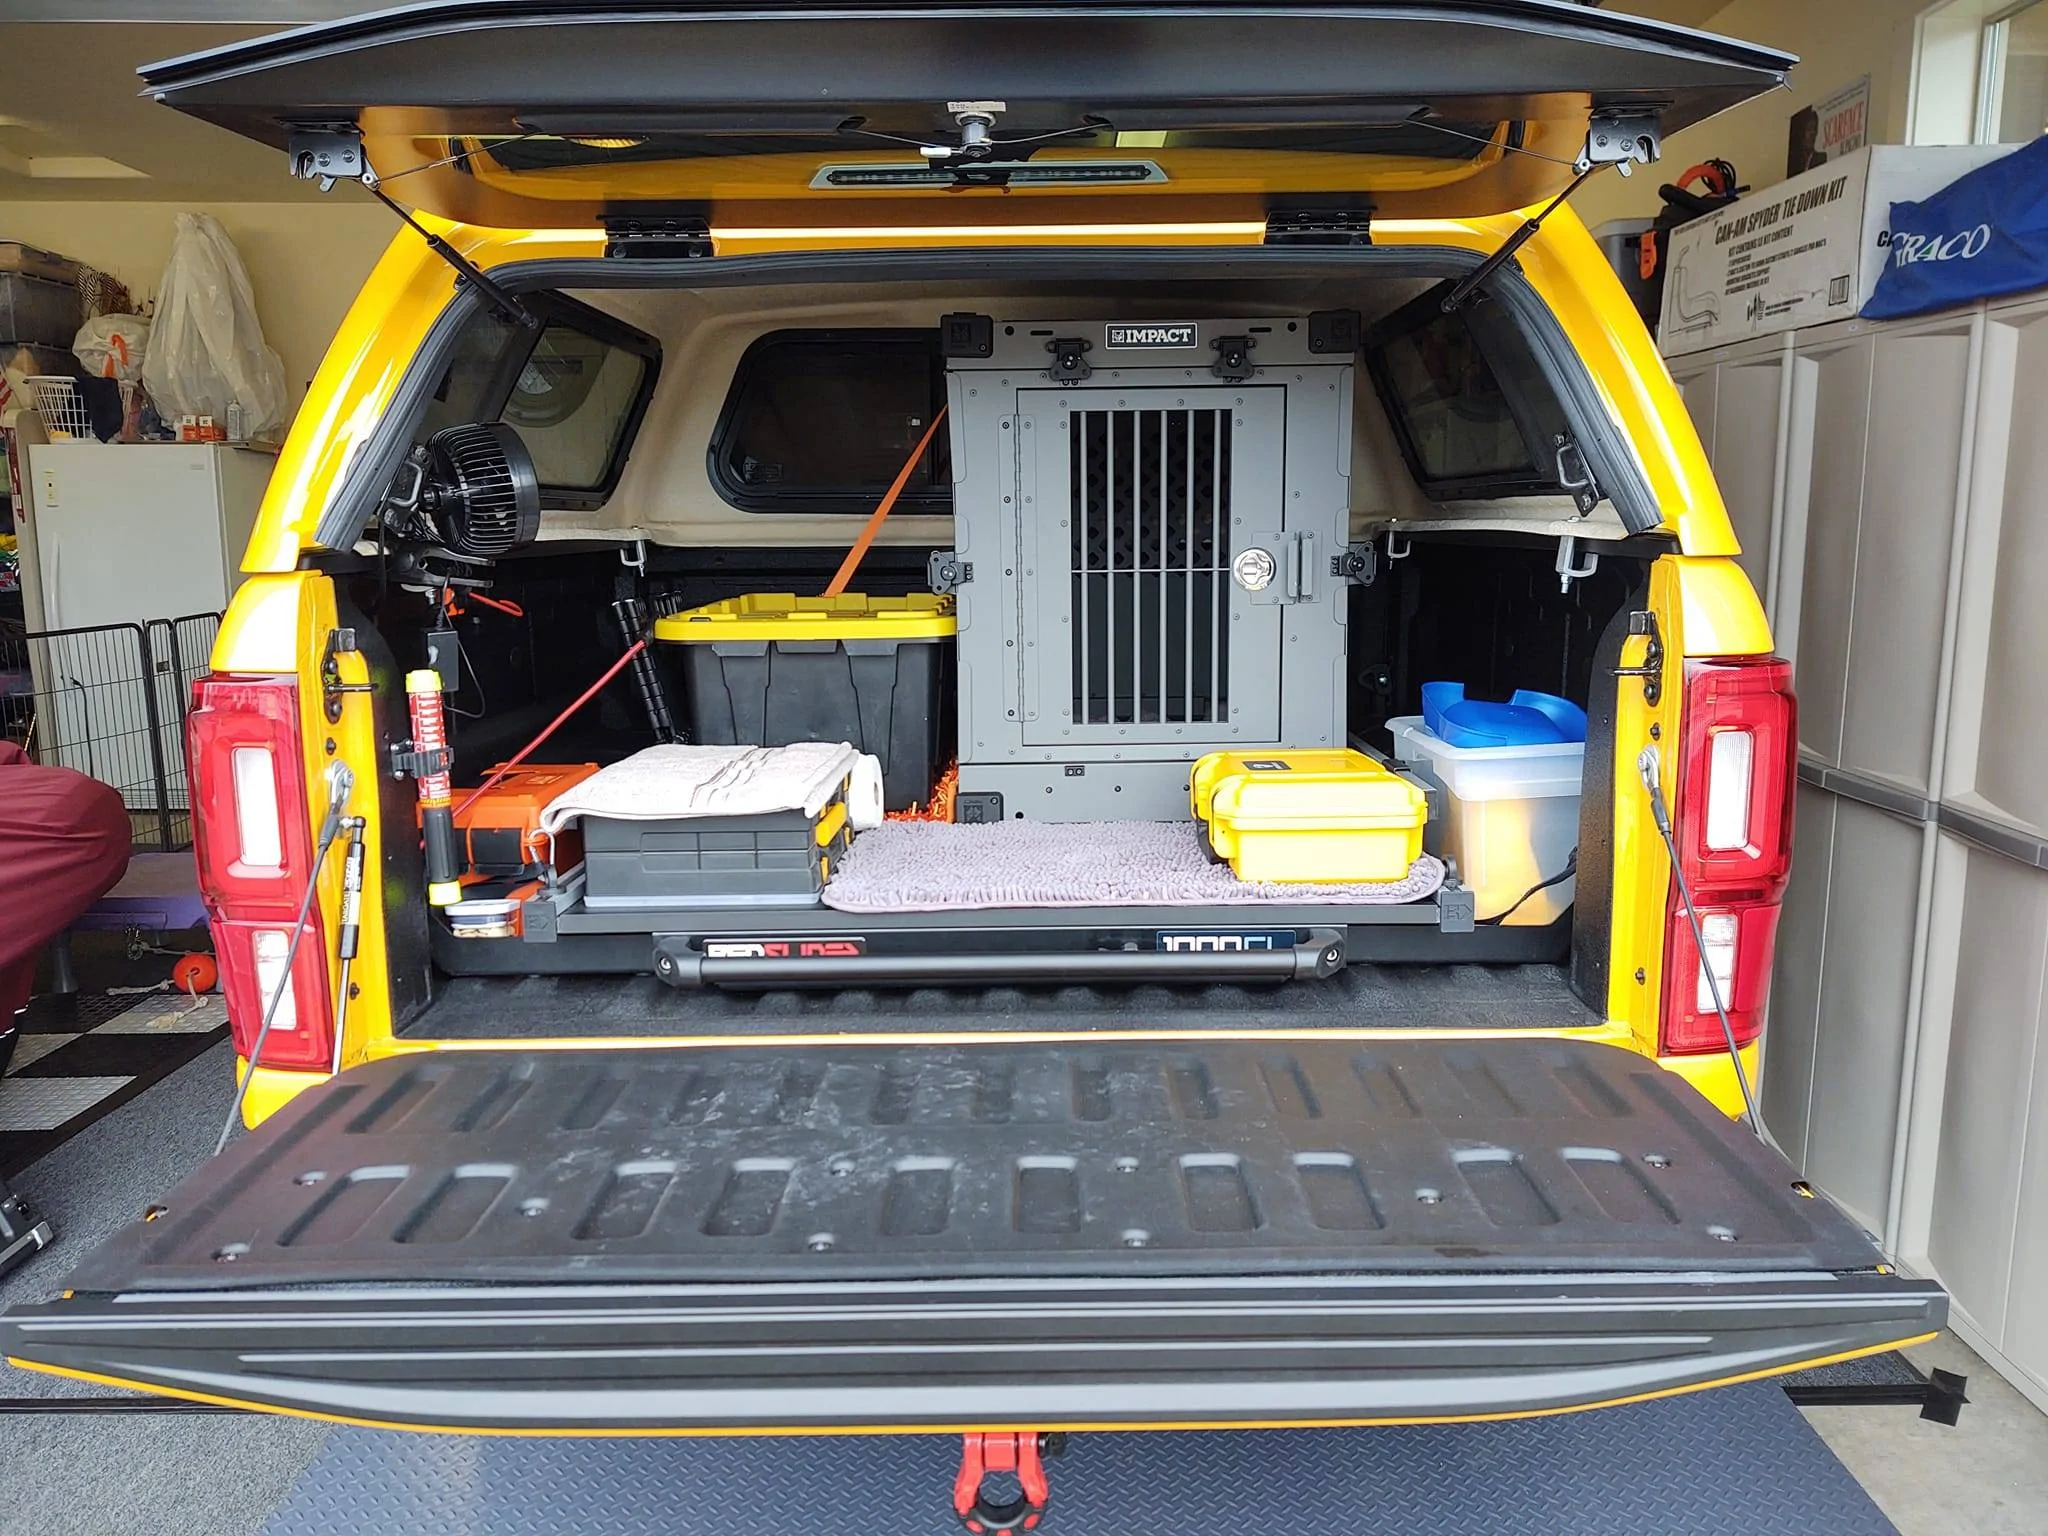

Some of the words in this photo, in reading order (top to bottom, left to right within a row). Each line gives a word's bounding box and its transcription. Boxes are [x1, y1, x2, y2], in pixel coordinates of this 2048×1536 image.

[1747, 205, 1781, 233] SPYDER
[1782, 196, 1797, 219] TIE
[1796, 183, 1828, 214] DOWN
[1827, 175, 1848, 203] KIT
[1892, 223, 1992, 269] GRACO
[1125, 329, 1192, 344] IMPACT
